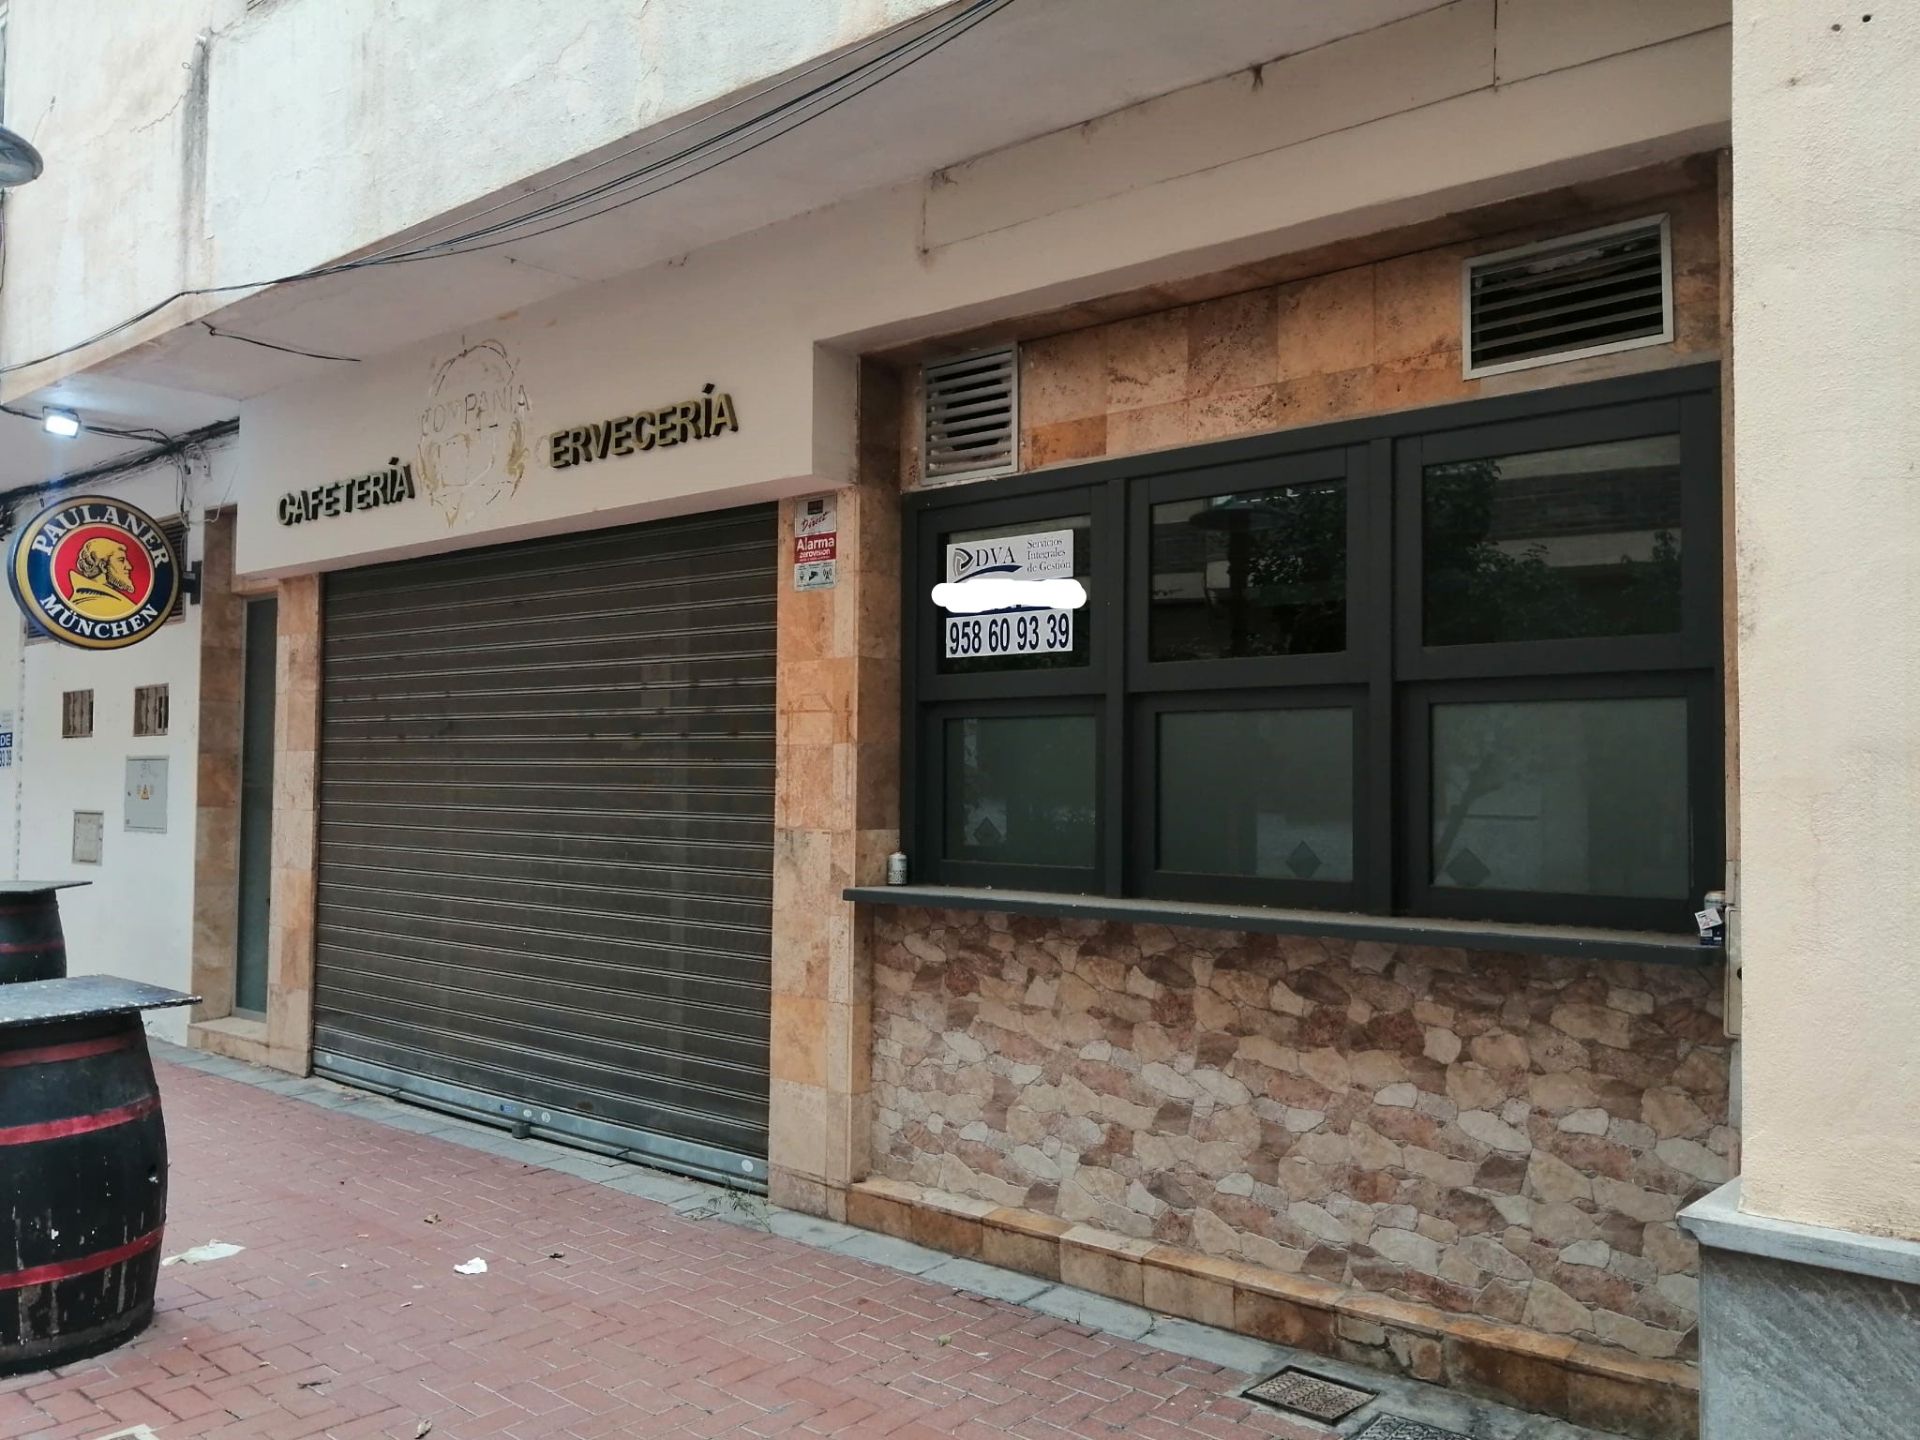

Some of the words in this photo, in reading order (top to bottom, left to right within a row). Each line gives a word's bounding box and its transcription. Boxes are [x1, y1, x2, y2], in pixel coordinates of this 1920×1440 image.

[277, 457, 416, 526] CAFETERÍA
[32, 504, 169, 568] PAULANER
[796, 536, 835, 553] Alarma
[1027, 537, 1064, 550] Servicios
[976, 546, 1017, 567] DVA
[1027, 549, 1066, 562] Integrales
[1027, 562, 1037, 573] de
[1039, 560, 1071, 573] Gestión
[40, 594, 159, 639] MÜNCHEN
[949, 620, 982, 655] 958
[988, 617, 1010, 653] 60
[1017, 615, 1040, 651] 93
[1046, 613, 1070, 649] 39
[0, 734, 11, 746] DE
